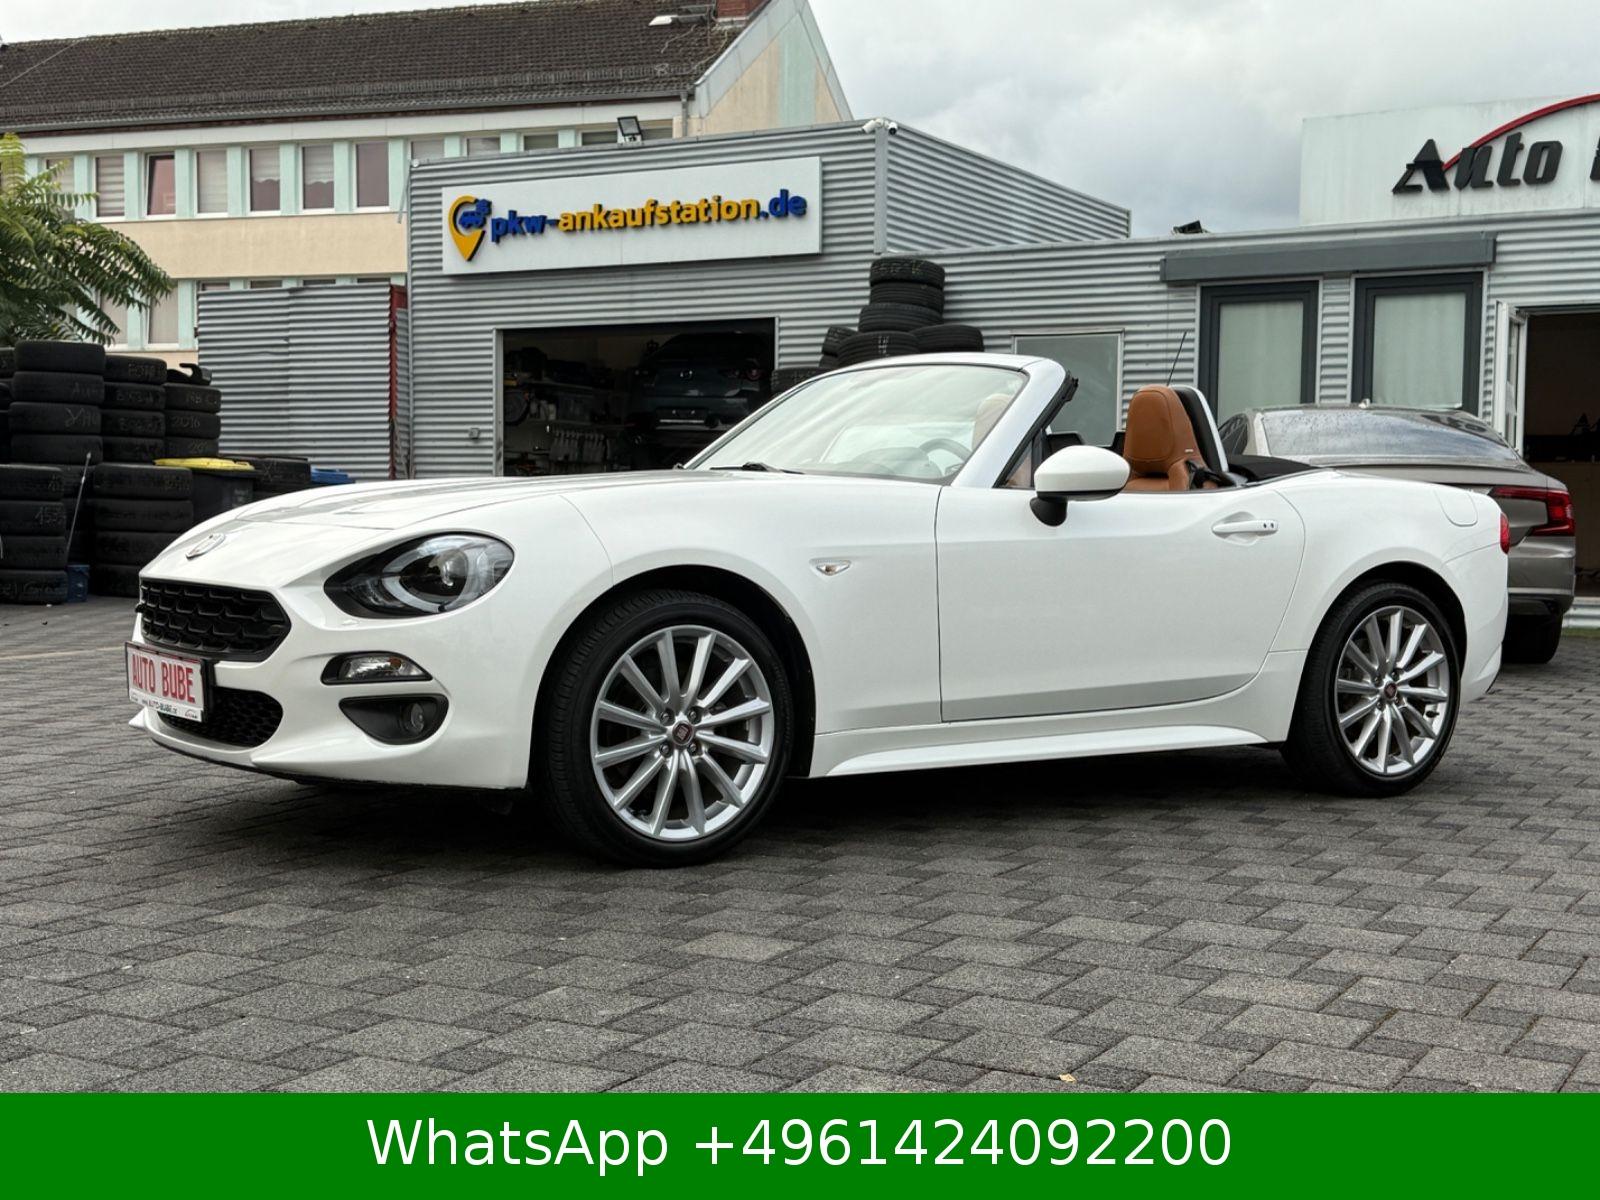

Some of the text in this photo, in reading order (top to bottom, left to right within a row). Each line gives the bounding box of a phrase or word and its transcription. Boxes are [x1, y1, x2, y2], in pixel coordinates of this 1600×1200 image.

[1391, 132, 1563, 194] Auto
[491, 189, 807, 242] pkw-ankaufstation.de
[132, 654, 196, 703] AUTO BUBE
